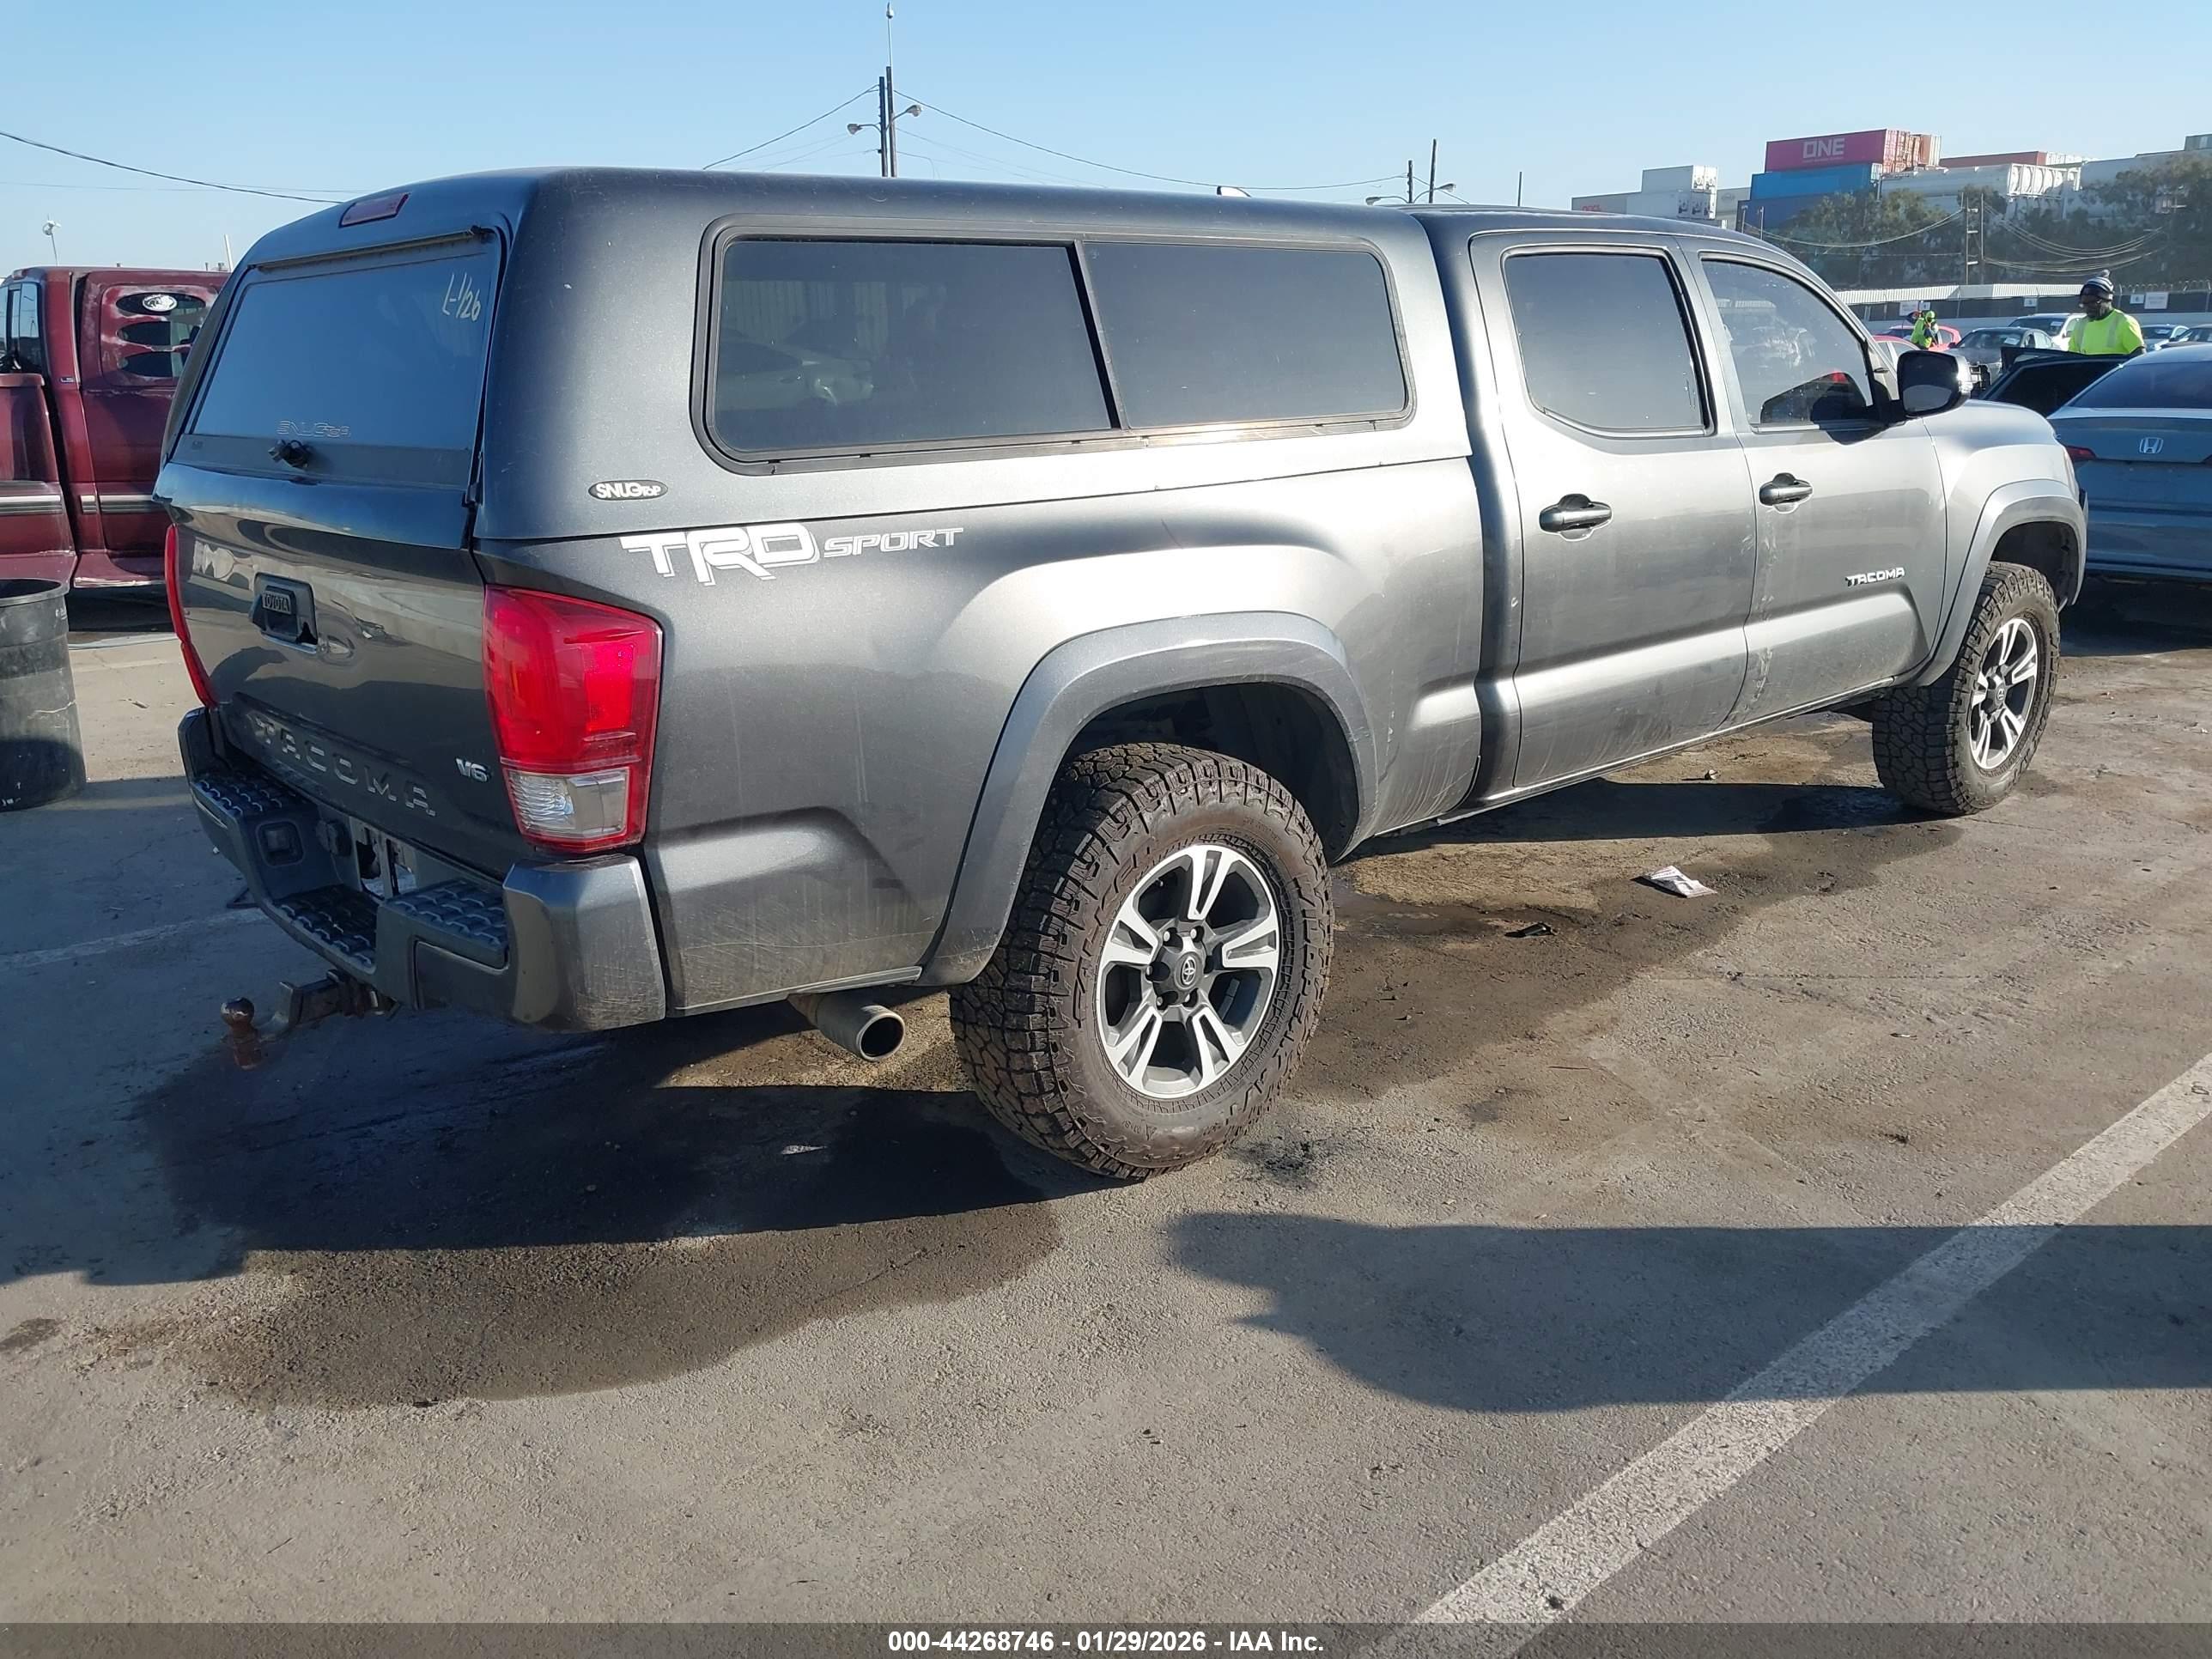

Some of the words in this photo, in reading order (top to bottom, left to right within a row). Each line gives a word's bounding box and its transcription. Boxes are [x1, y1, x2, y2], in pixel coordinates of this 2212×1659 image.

[1803, 138, 1845, 158] ONE
[619, 522, 820, 586] TRD
[823, 527, 964, 558] SPORT
[1845, 567, 1905, 586] TACOMA
[263, 592, 291, 612] TOYOTA
[250, 714, 436, 817] TACOMA
[456, 757, 489, 782] V6
